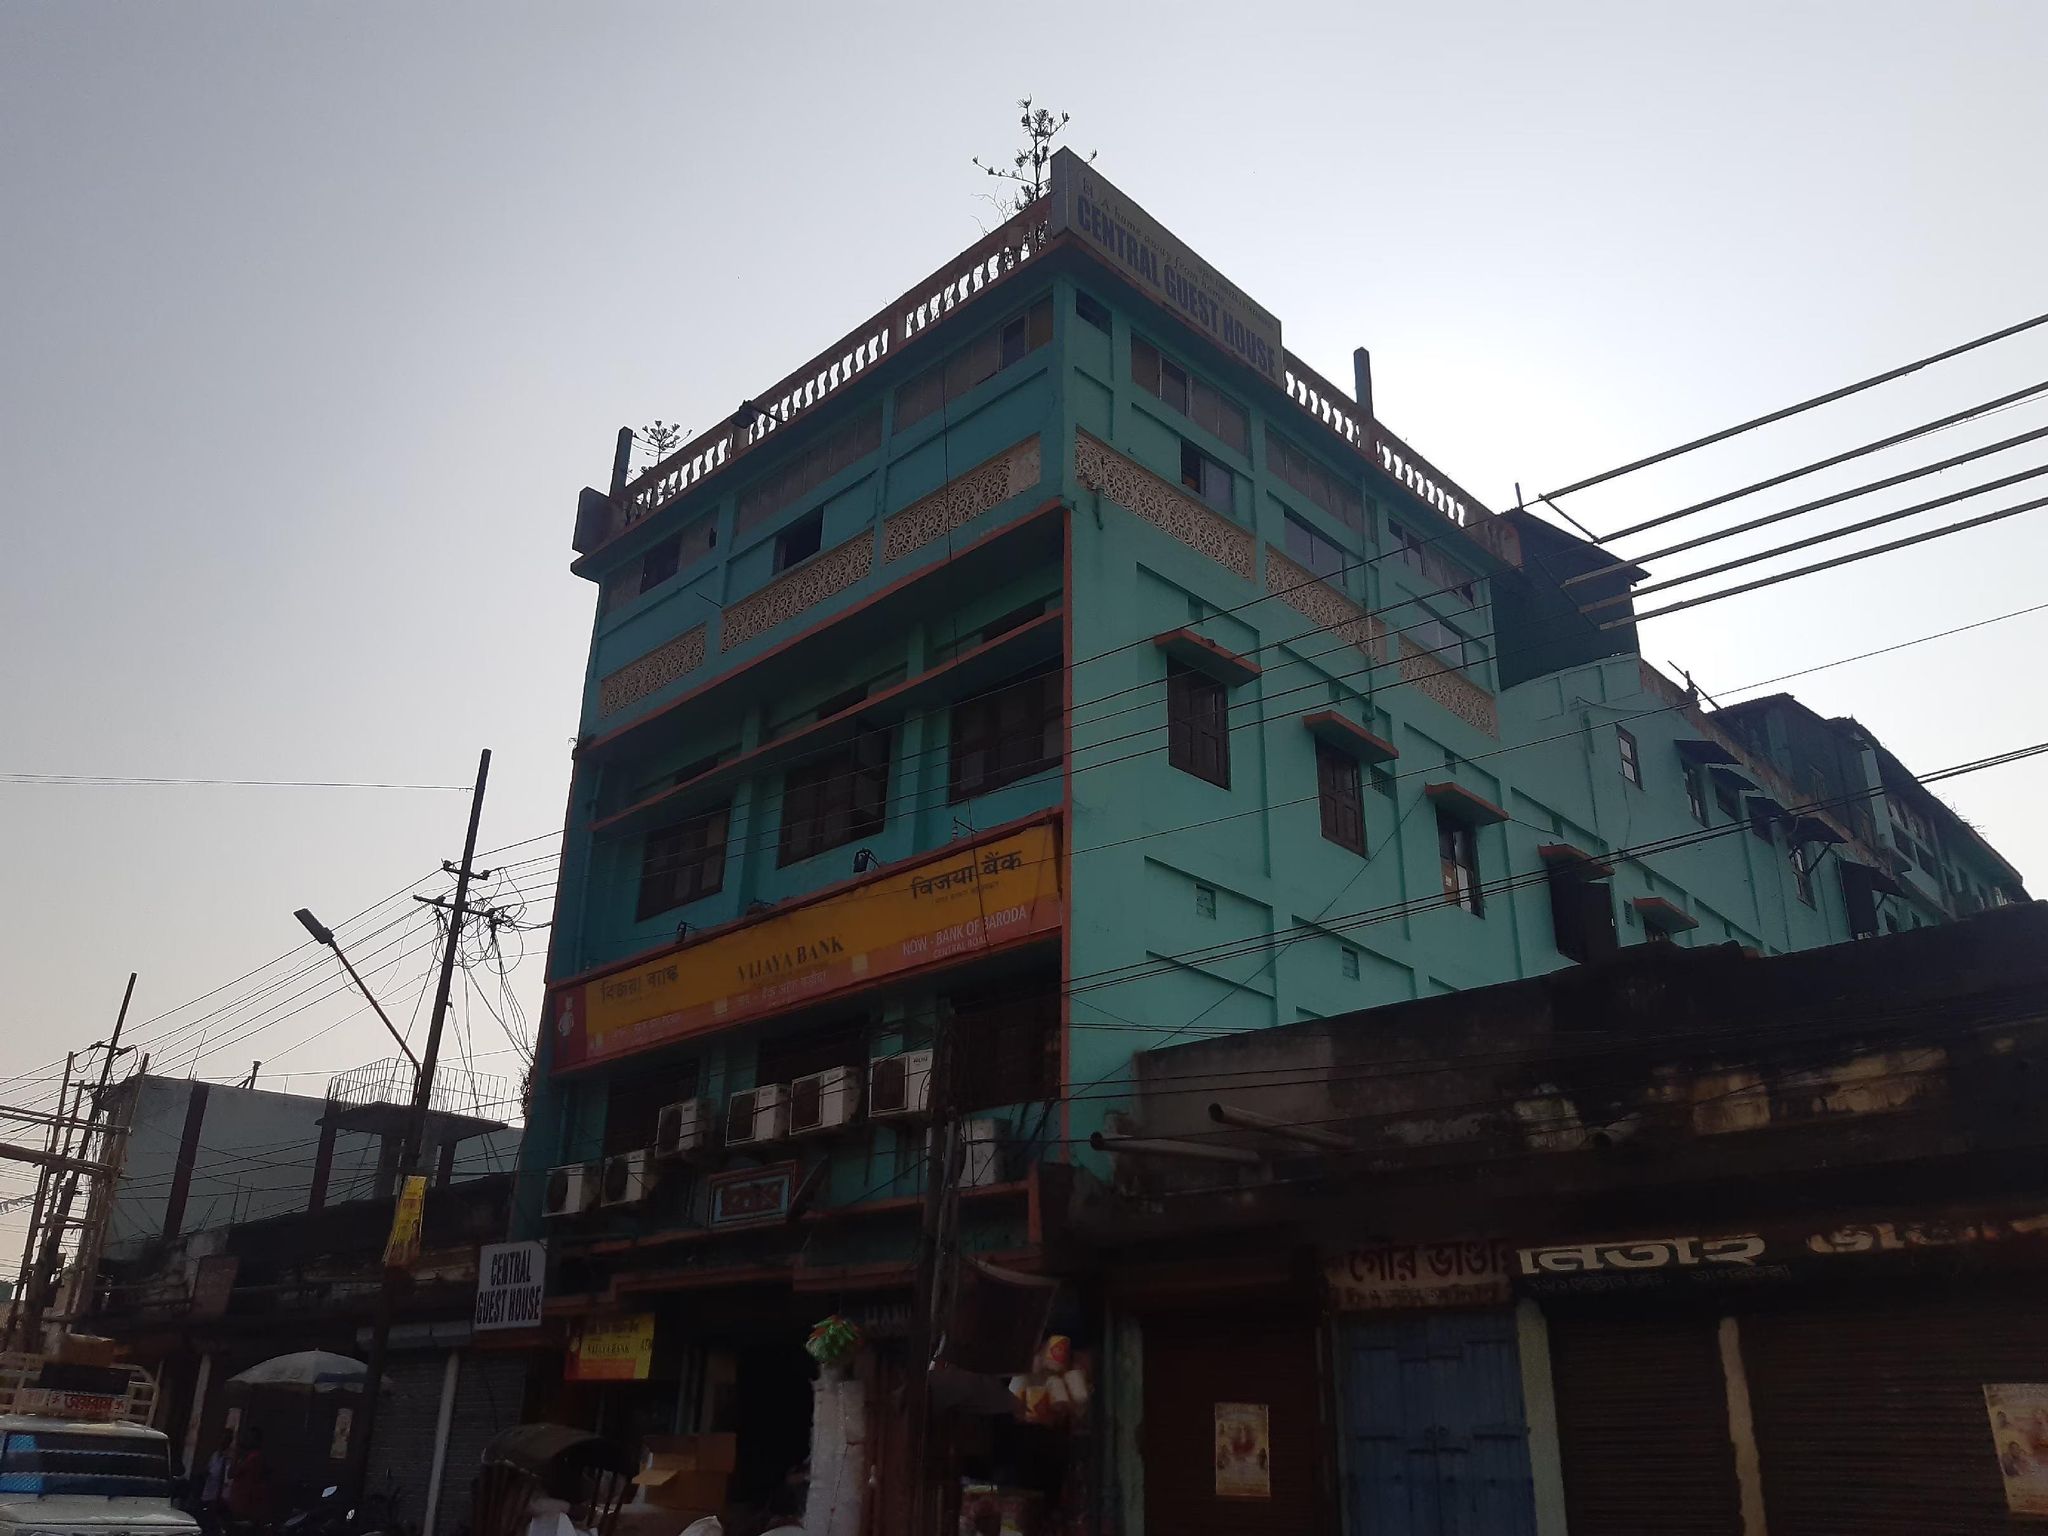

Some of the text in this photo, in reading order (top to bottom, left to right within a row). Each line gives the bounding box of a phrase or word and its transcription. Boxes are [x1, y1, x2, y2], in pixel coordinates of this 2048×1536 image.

[1077, 194, 1160, 288] CENTRAL
[1164, 263, 1218, 333] GUEST
[1222, 309, 1275, 380] HOUSE
[910, 865, 975, 900] विजया
[981, 850, 1022, 876] बैंक
[903, 935, 928, 956] NOW
[936, 924, 965, 946] BANK
[966, 918, 981, 936] OF
[983, 905, 1027, 931] BARODA
[736, 935, 844, 983] VIJAYA BANK
[490, 1249, 532, 1286] CENTRAL
[476, 1284, 542, 1325] GUEST HOUSE
